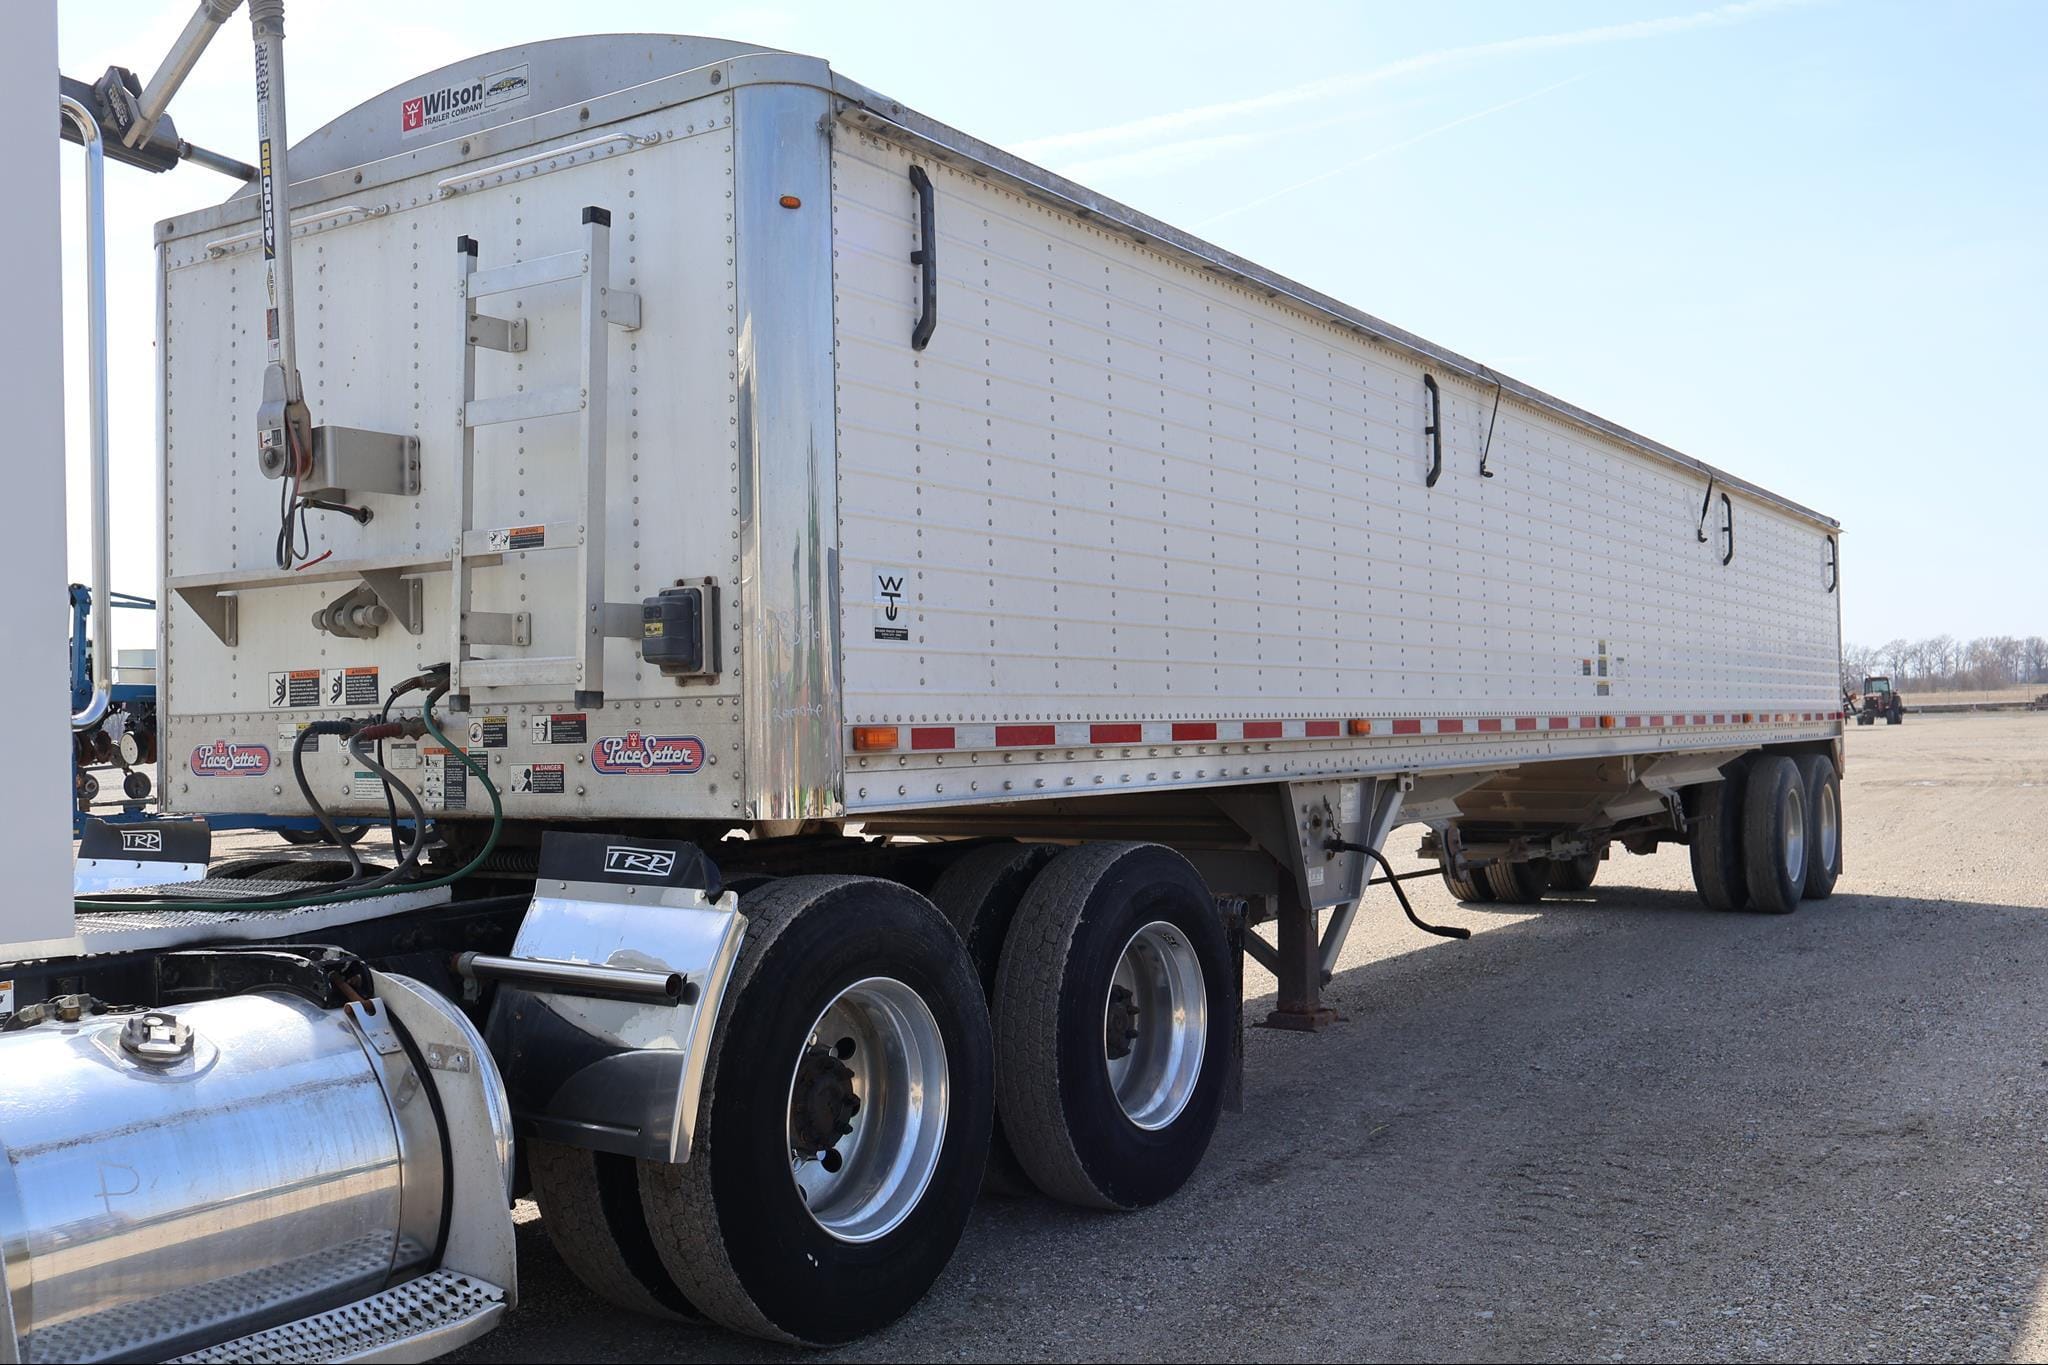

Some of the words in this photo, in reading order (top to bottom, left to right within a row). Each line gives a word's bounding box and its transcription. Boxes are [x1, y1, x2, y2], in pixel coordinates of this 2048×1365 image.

[258, 45, 266, 77] STEP
[259, 80, 267, 100] NO
[423, 83, 483, 116] Wilson
[424, 113, 450, 127] TRAILER
[451, 102, 483, 117] COMPANY
[262, 142, 273, 246] 4500HD
[199, 744, 263, 771] PaceSetter
[603, 736, 694, 768] PaceSetter
[123, 833, 160, 850] TRP
[608, 851, 672, 874] TRP
